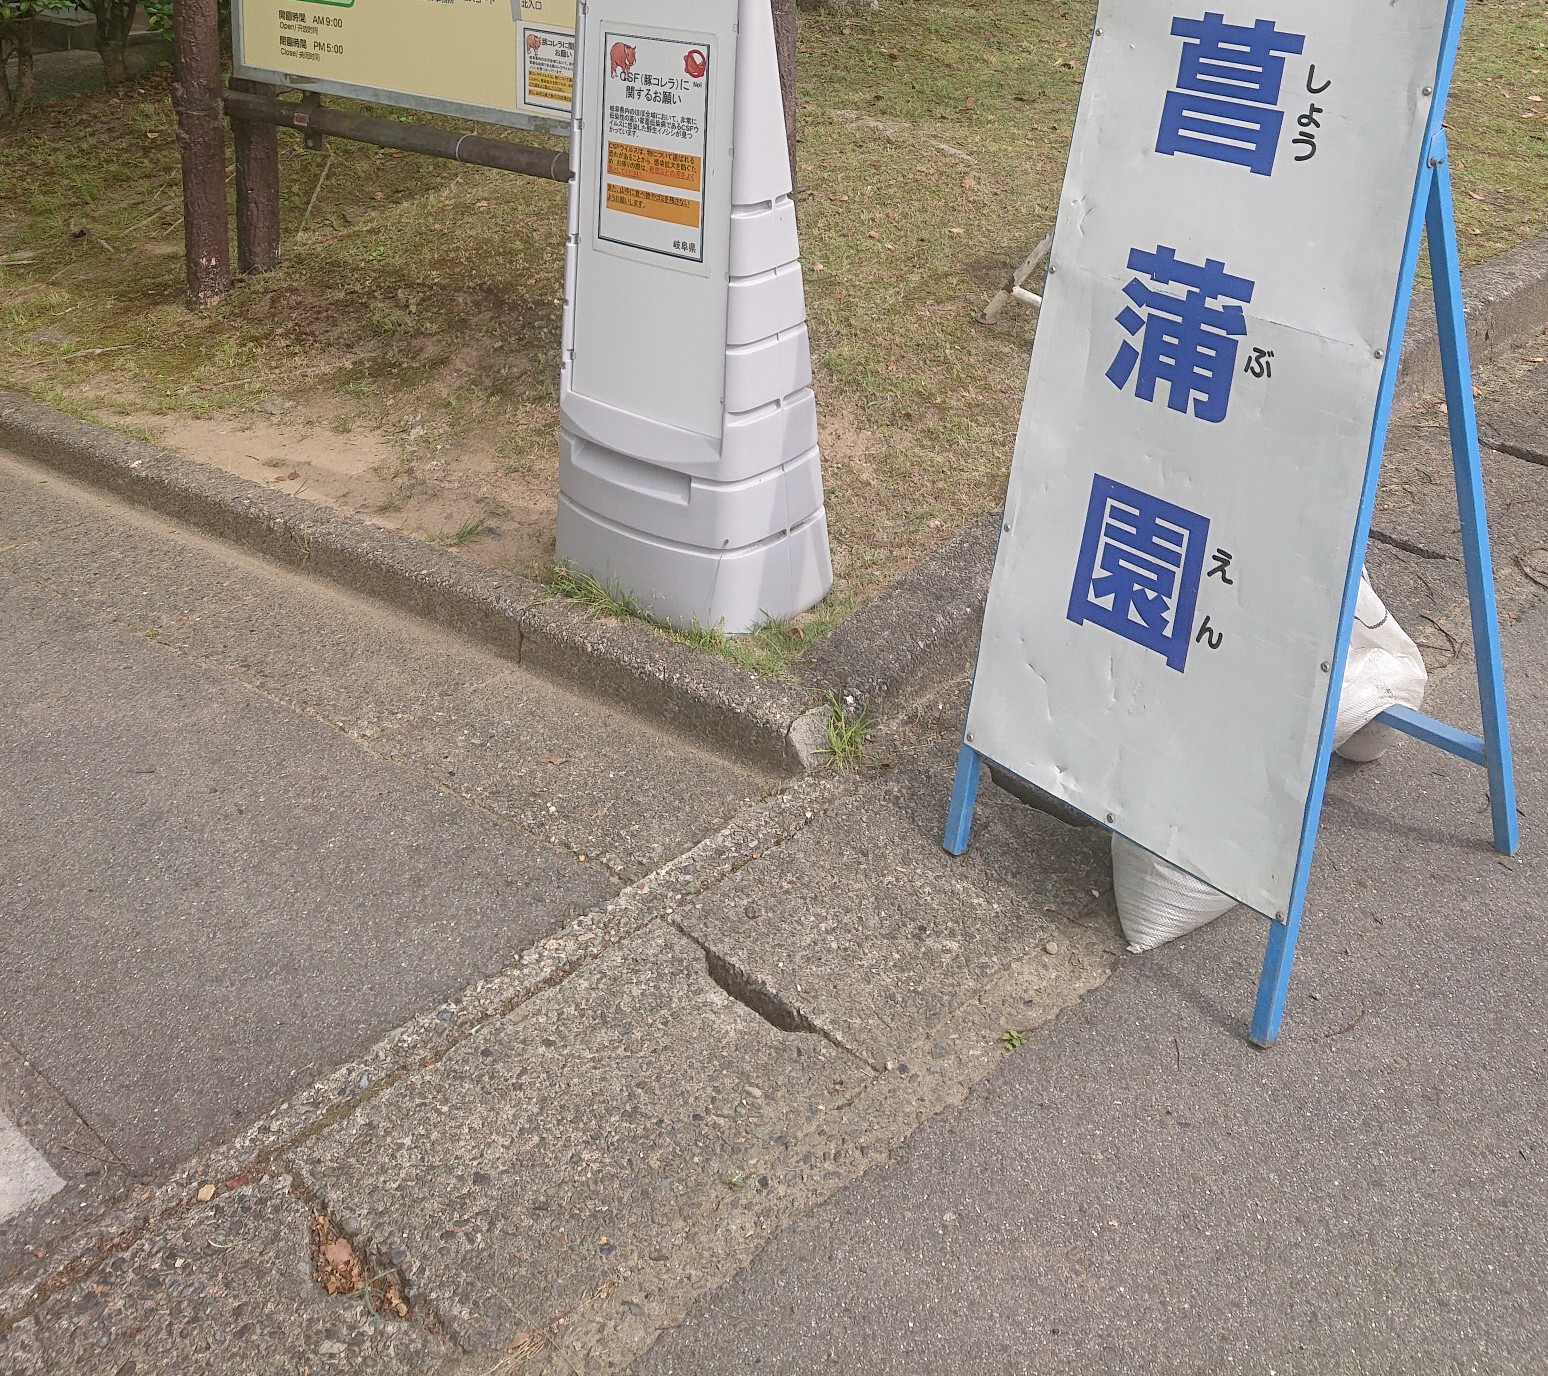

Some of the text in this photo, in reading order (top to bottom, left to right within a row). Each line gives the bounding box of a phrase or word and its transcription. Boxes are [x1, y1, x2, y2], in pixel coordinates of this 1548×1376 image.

[521, 0, 542, 10] 北入口
[626, 86, 681, 104] 関するお願い
[1292, 64, 1331, 161] しょう
[673, 240, 696, 253] 岐阜県
[1067, 12, 1305, 673] 菖蒲園
[1244, 347, 1274, 378] ぶ
[1196, 548, 1233, 649] えん
